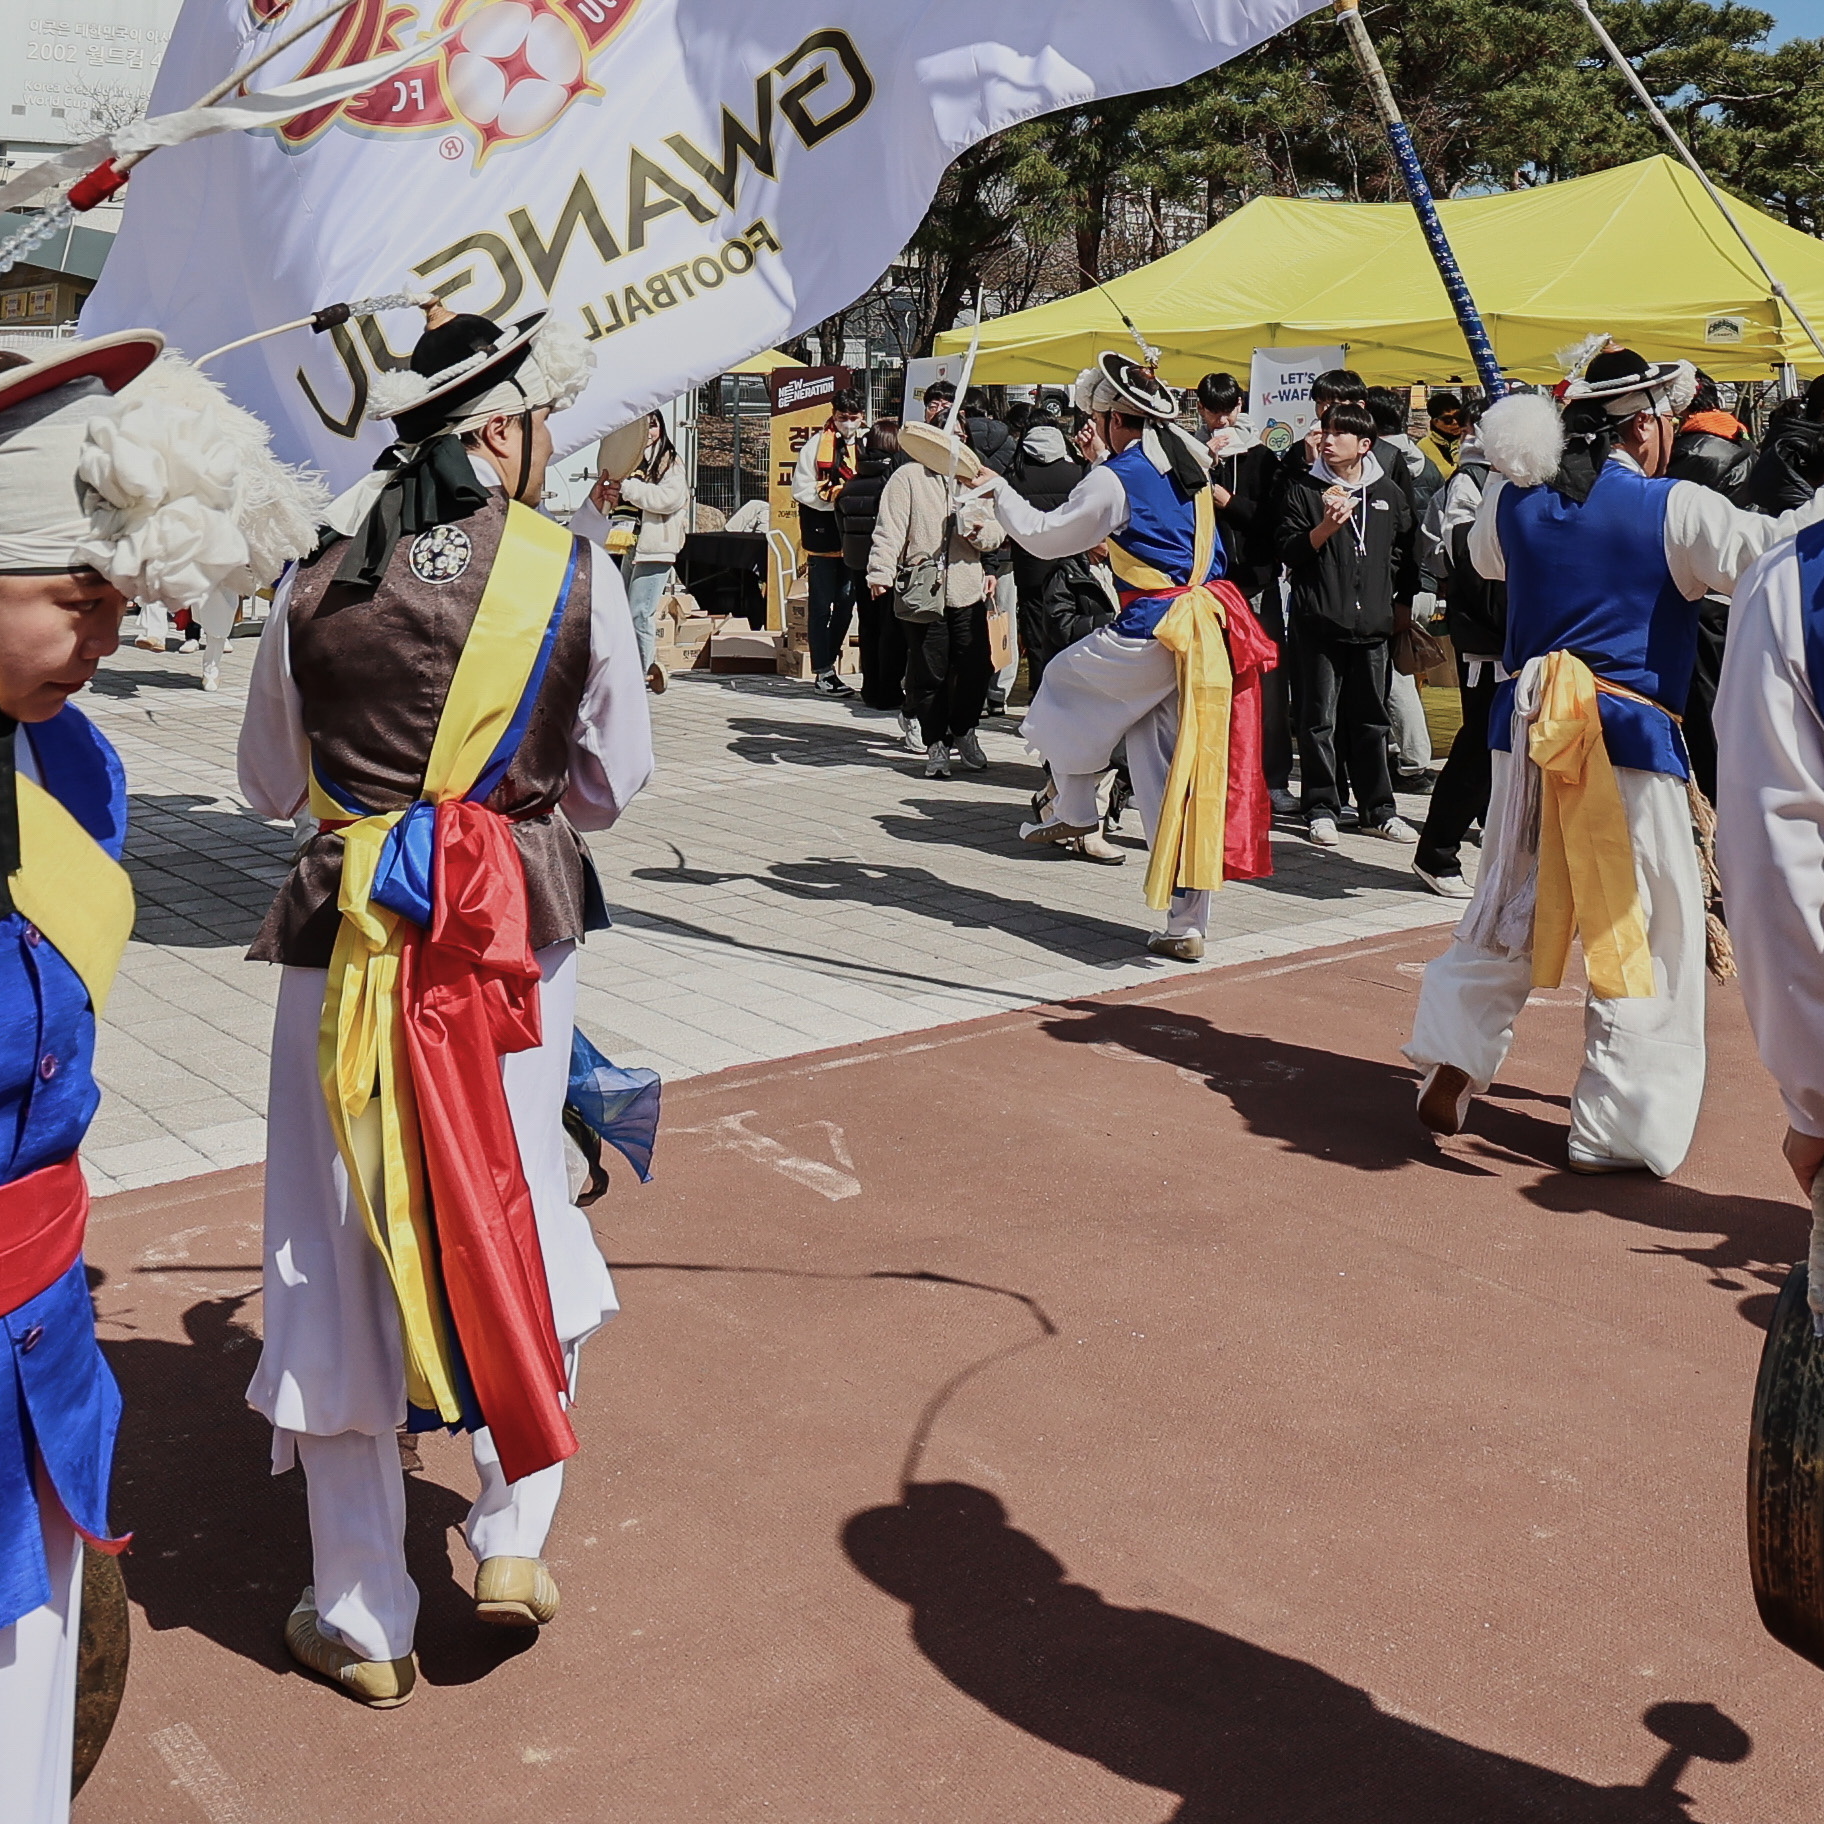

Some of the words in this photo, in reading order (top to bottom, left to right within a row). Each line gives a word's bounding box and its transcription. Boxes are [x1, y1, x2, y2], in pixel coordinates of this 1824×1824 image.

[28, 18, 71, 38] 이곳은
[74, 22, 142, 43] 대한민국이
[26, 41, 78, 64] 2002
[85, 44, 144, 70] 월드컵
[23, 80, 61, 93] Korea
[23, 94, 60, 107] World
[63, 97, 89, 110] Cup
[778, 378, 804, 398] NEW
[778, 381, 835, 409] GENERATION
